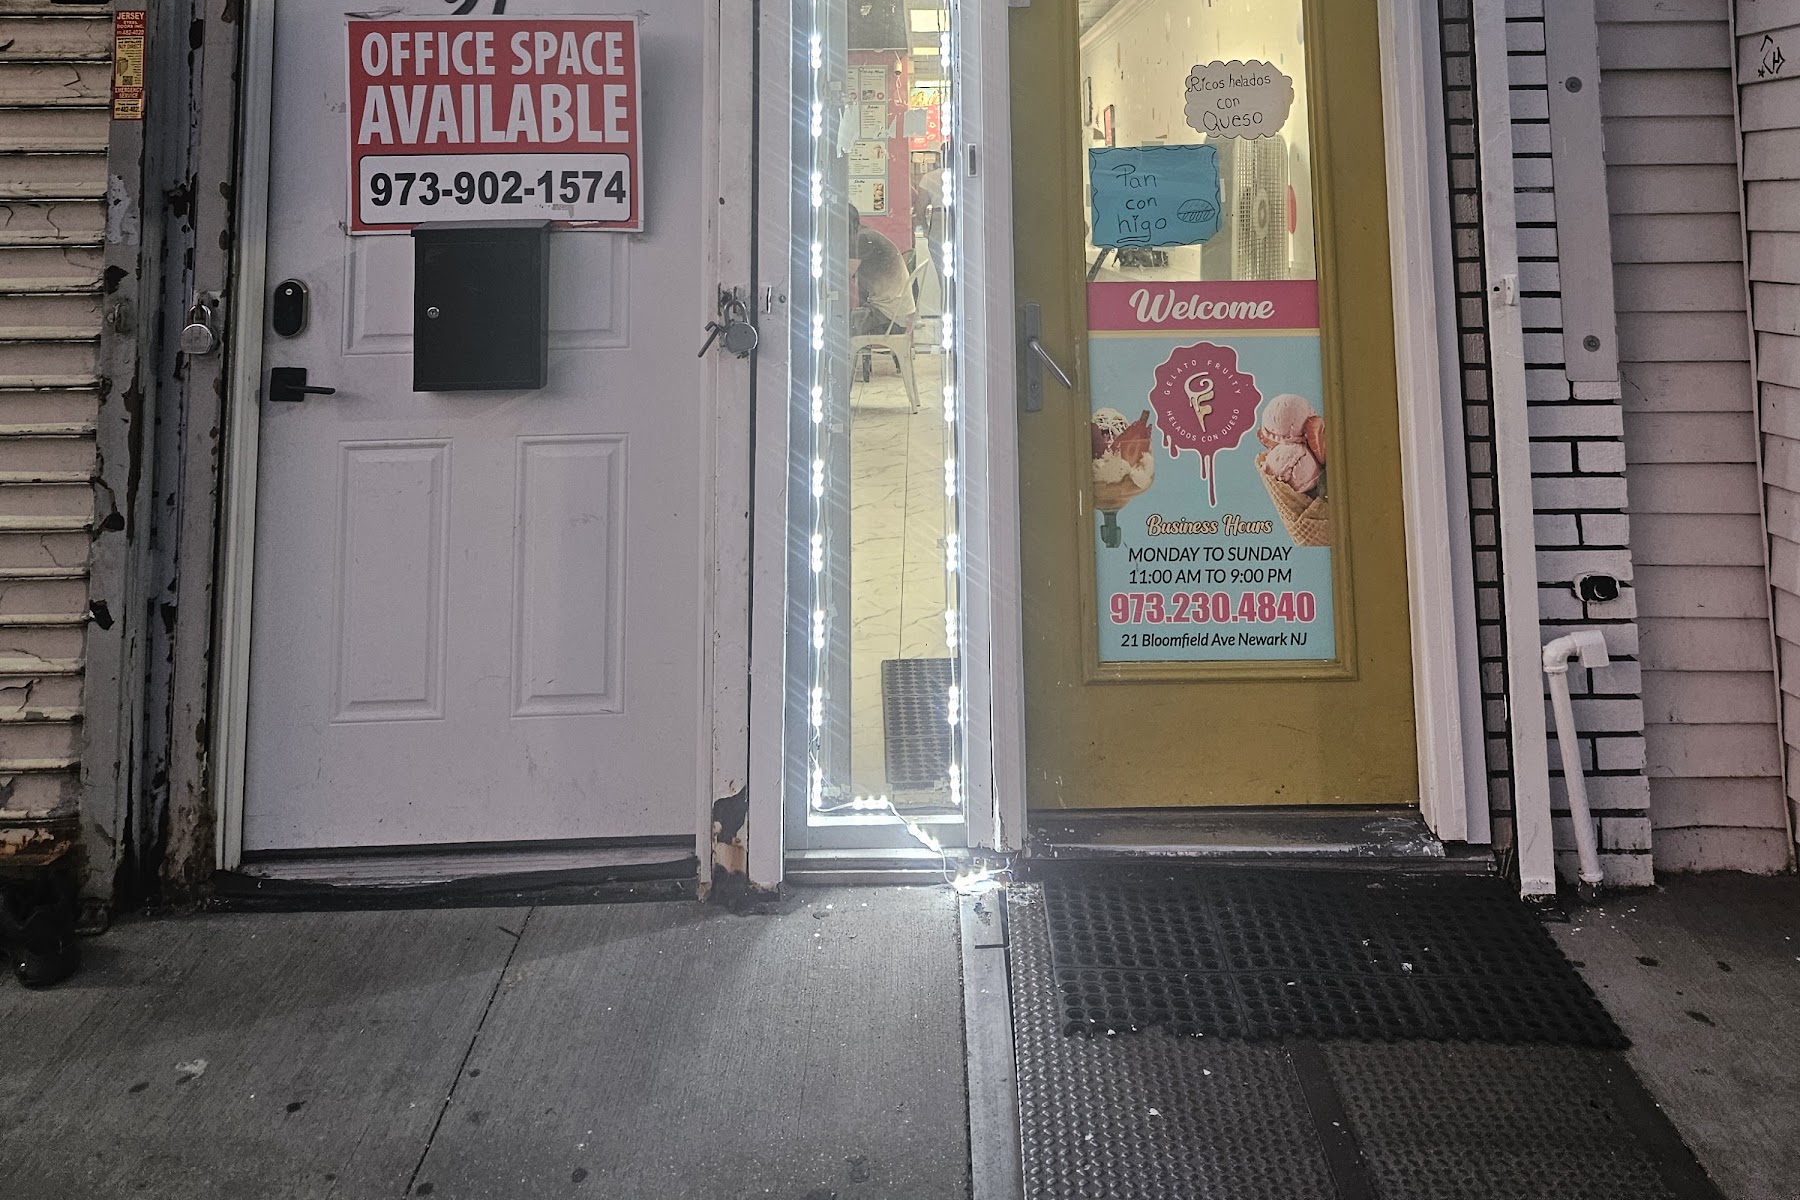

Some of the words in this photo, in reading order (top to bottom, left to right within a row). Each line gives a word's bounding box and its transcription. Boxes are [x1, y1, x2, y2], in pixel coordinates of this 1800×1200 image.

[116, 12, 145, 20] JERSEY
[361, 31, 496, 77] OFFICE
[510, 31, 625, 76] SPACE
[1187, 75, 1225, 92] Ricos
[1228, 74, 1272, 87] helados
[357, 83, 630, 145] AVAILABLE
[1216, 97, 1241, 110] con
[1202, 111, 1264, 131] Queso
[370, 170, 627, 206] 973-902-1574
[1111, 164, 1158, 189] Pan
[1125, 196, 1158, 211] con
[1116, 212, 1168, 243] higo
[1128, 288, 1275, 324] Welcome
[1163, 359, 1197, 396] GELATO
[1207, 359, 1241, 395] FRUITY
[1166, 410, 1197, 442] HELADOS
[1201, 434, 1219, 443] CON
[1221, 408, 1240, 436] QUESO
[1146, 513, 1219, 536] Business
[1222, 513, 1273, 536] Hours
[1128, 547, 1201, 562] MONDAY
[1203, 547, 1225, 561] TO
[1228, 546, 1293, 561] SUNDAY
[1129, 569, 1172, 584] 11:00
[1175, 569, 1201, 583] AM
[1205, 569, 1226, 583] TO
[1231, 568, 1264, 583] 9:00
[1268, 568, 1292, 583] PM
[1110, 591, 1316, 625] 973.230.4840
[1121, 633, 1139, 647] 21
[1142, 632, 1209, 648] Bloomfield
[1211, 633, 1235, 646] Ave
[1238, 633, 1288, 646] Newark
[1291, 632, 1308, 646] NJ
